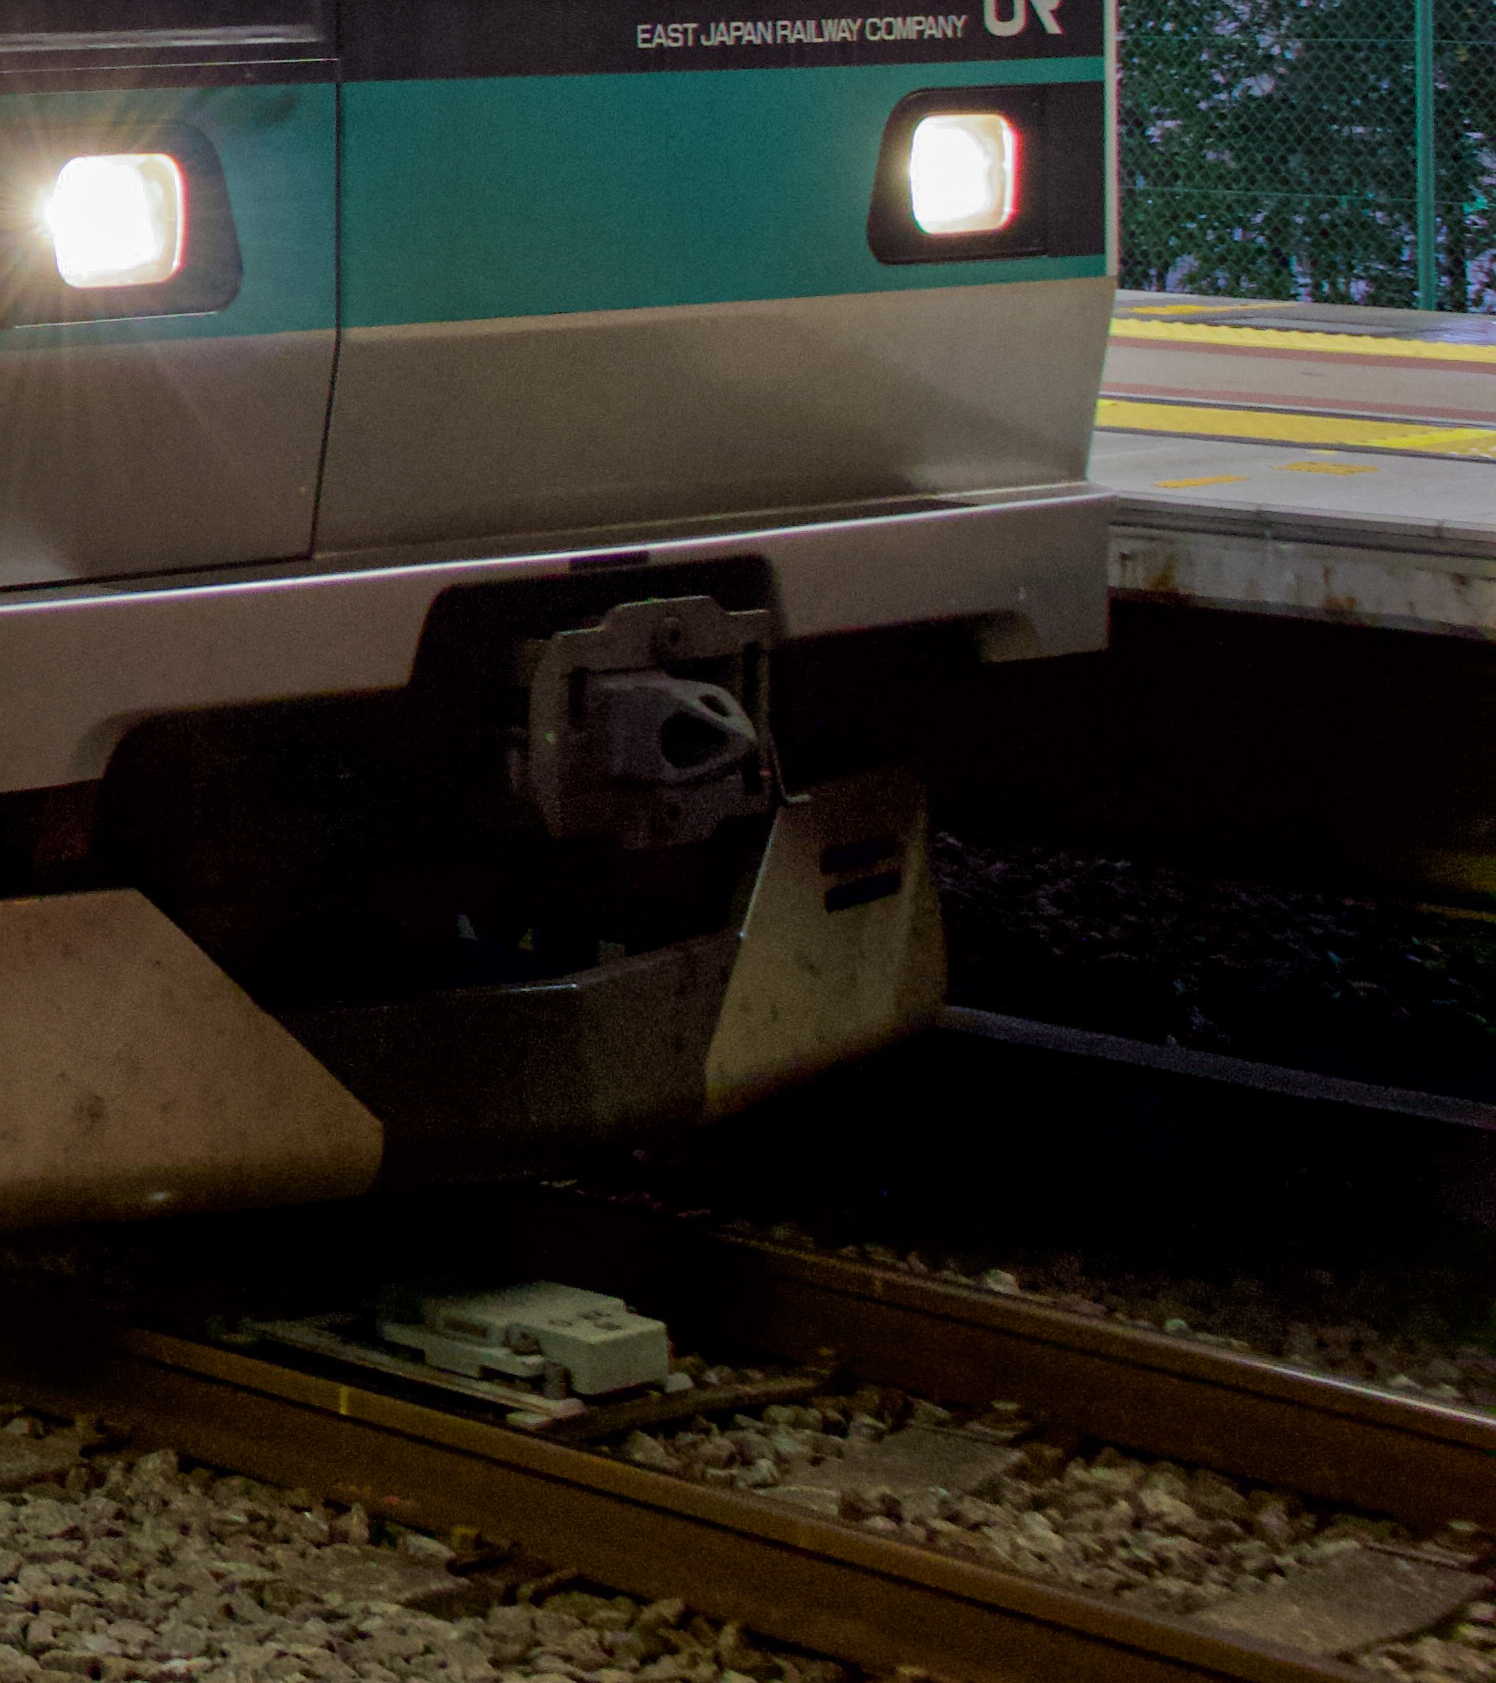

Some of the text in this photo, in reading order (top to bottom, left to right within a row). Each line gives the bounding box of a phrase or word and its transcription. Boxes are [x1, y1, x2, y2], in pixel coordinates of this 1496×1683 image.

[636, 14, 967, 49] EAST JAPAN RAILWAY COMPANY
